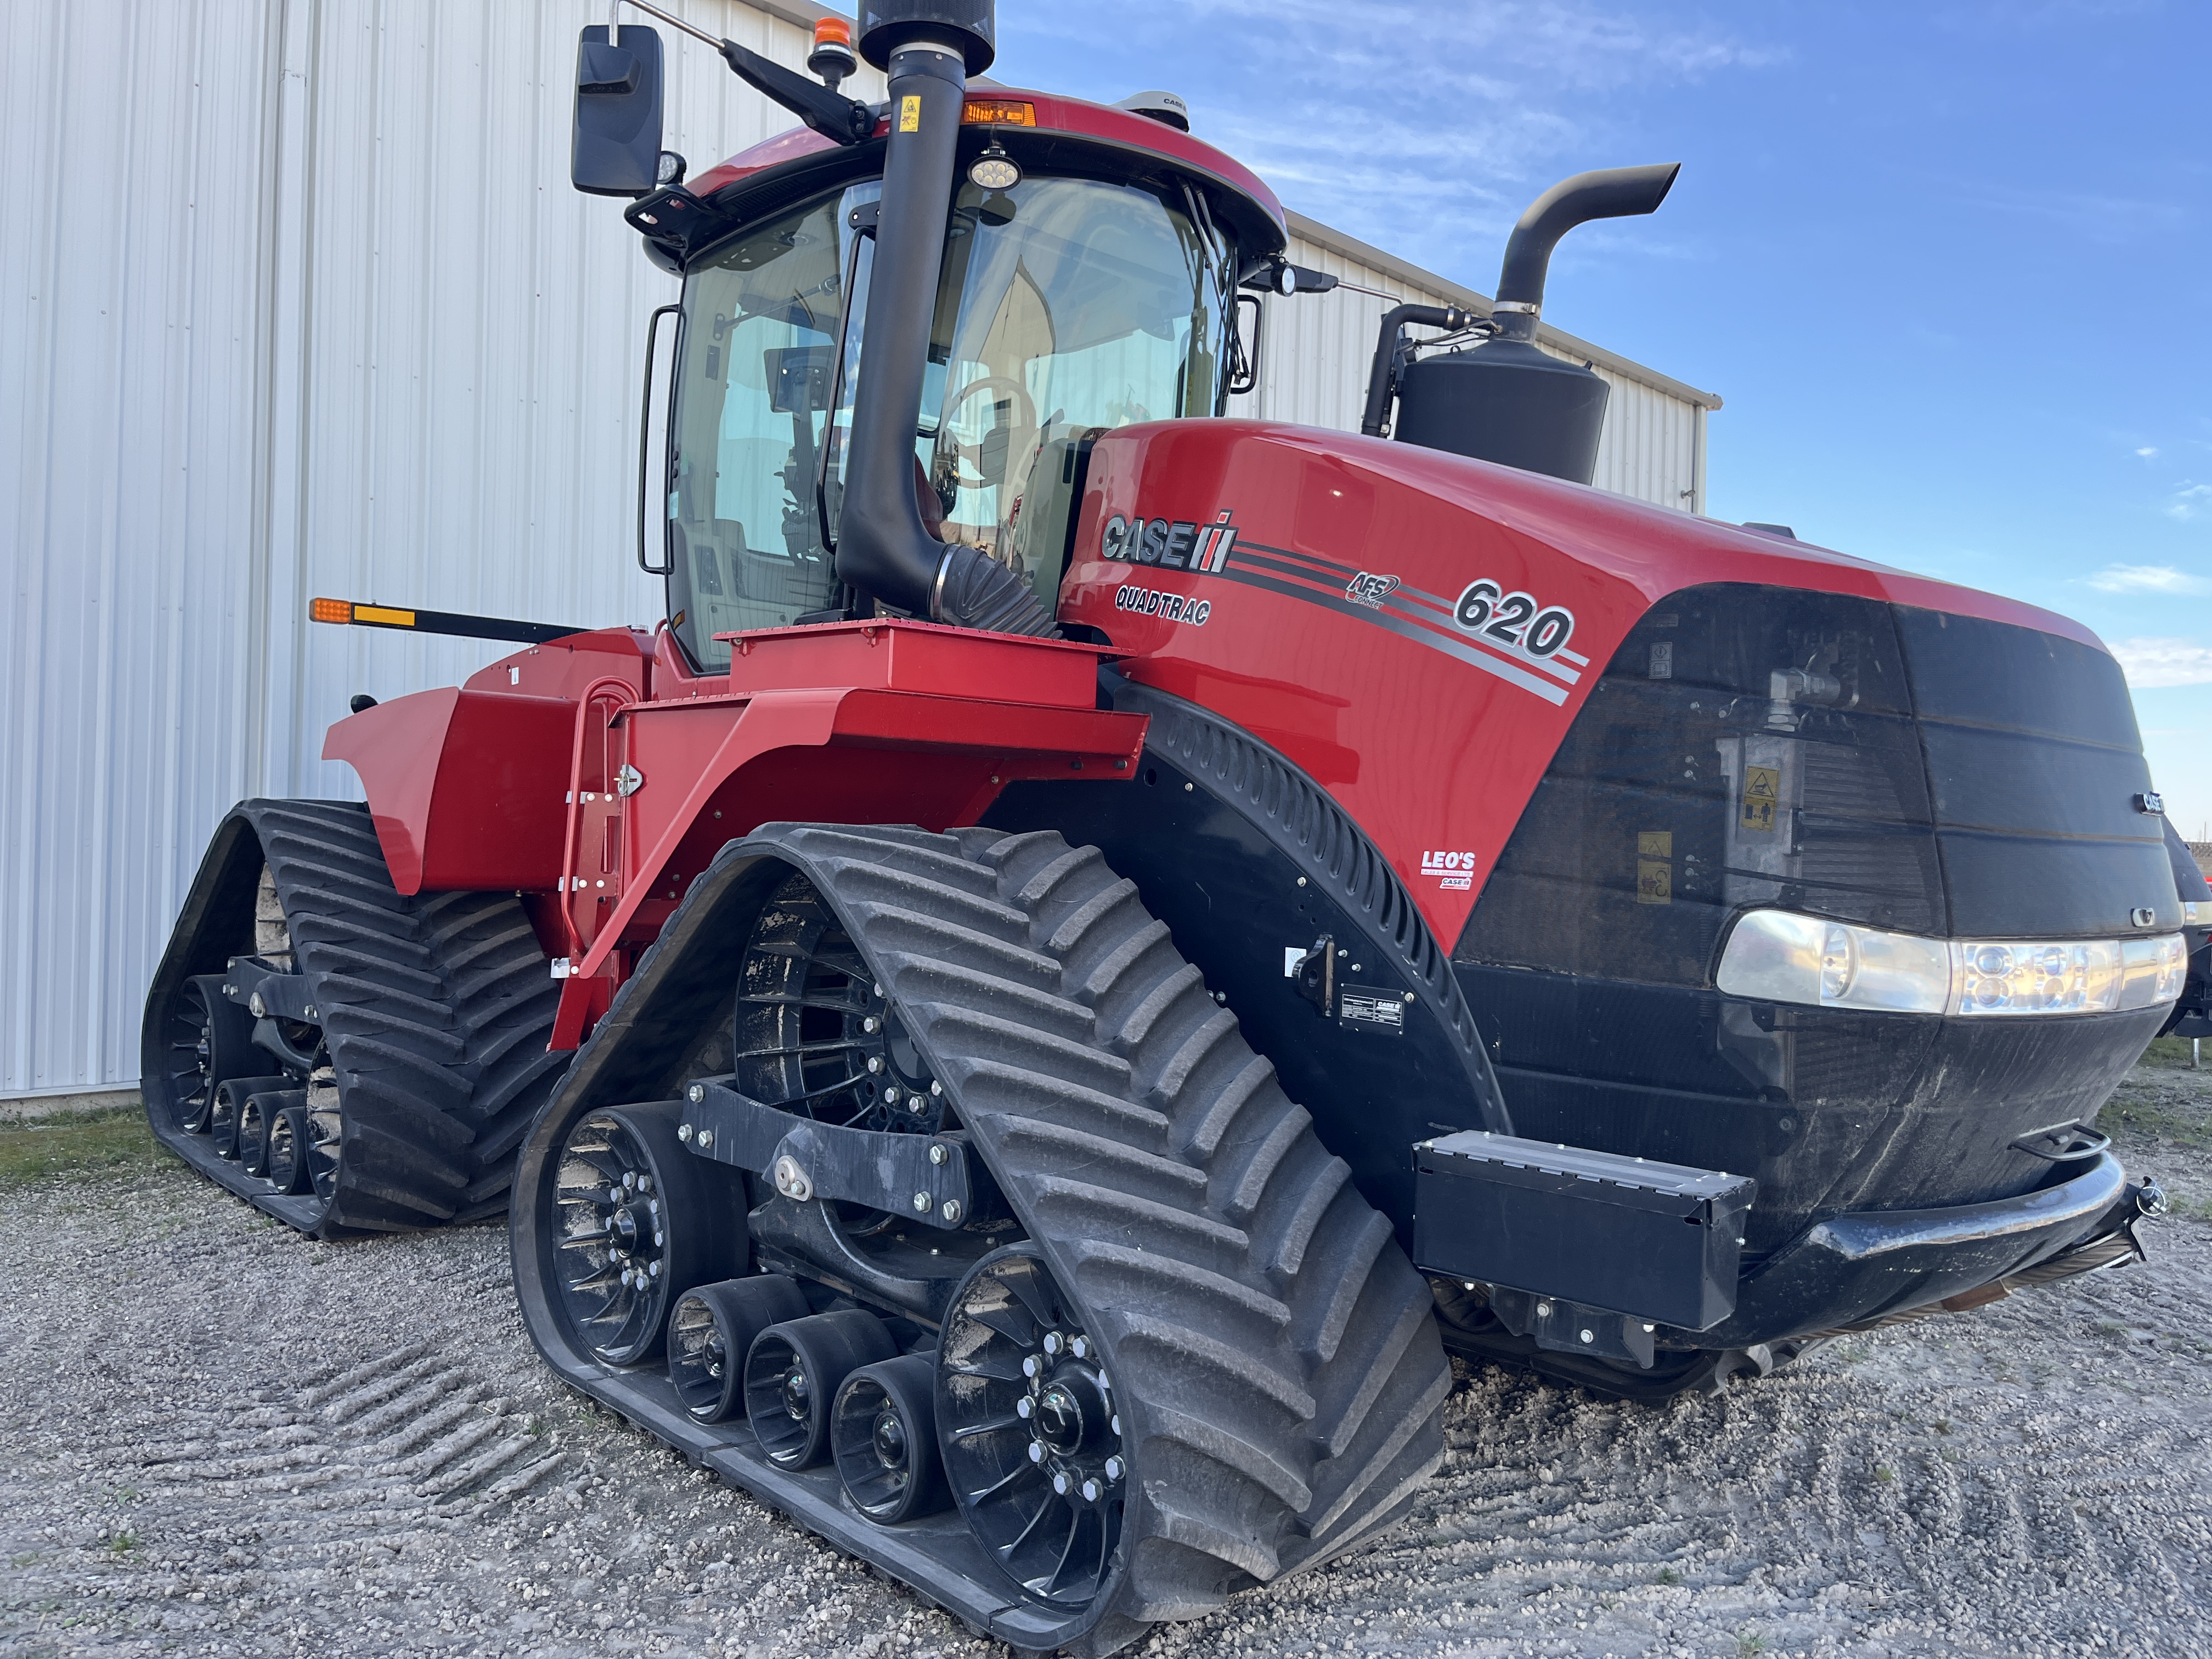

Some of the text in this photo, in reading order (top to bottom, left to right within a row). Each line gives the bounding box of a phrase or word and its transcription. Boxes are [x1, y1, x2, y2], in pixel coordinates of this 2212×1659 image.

[1164, 98, 1183, 109] CASE
[1102, 516, 1197, 567] CASE
[1347, 572, 1389, 597] AFS
[1115, 585, 1211, 626] QUADTRAC
[1355, 595, 1383, 609] CONNECT
[1454, 578, 1574, 659] 620
[2143, 794, 2161, 811] CASE
[1421, 851, 1475, 870] LEO'S
